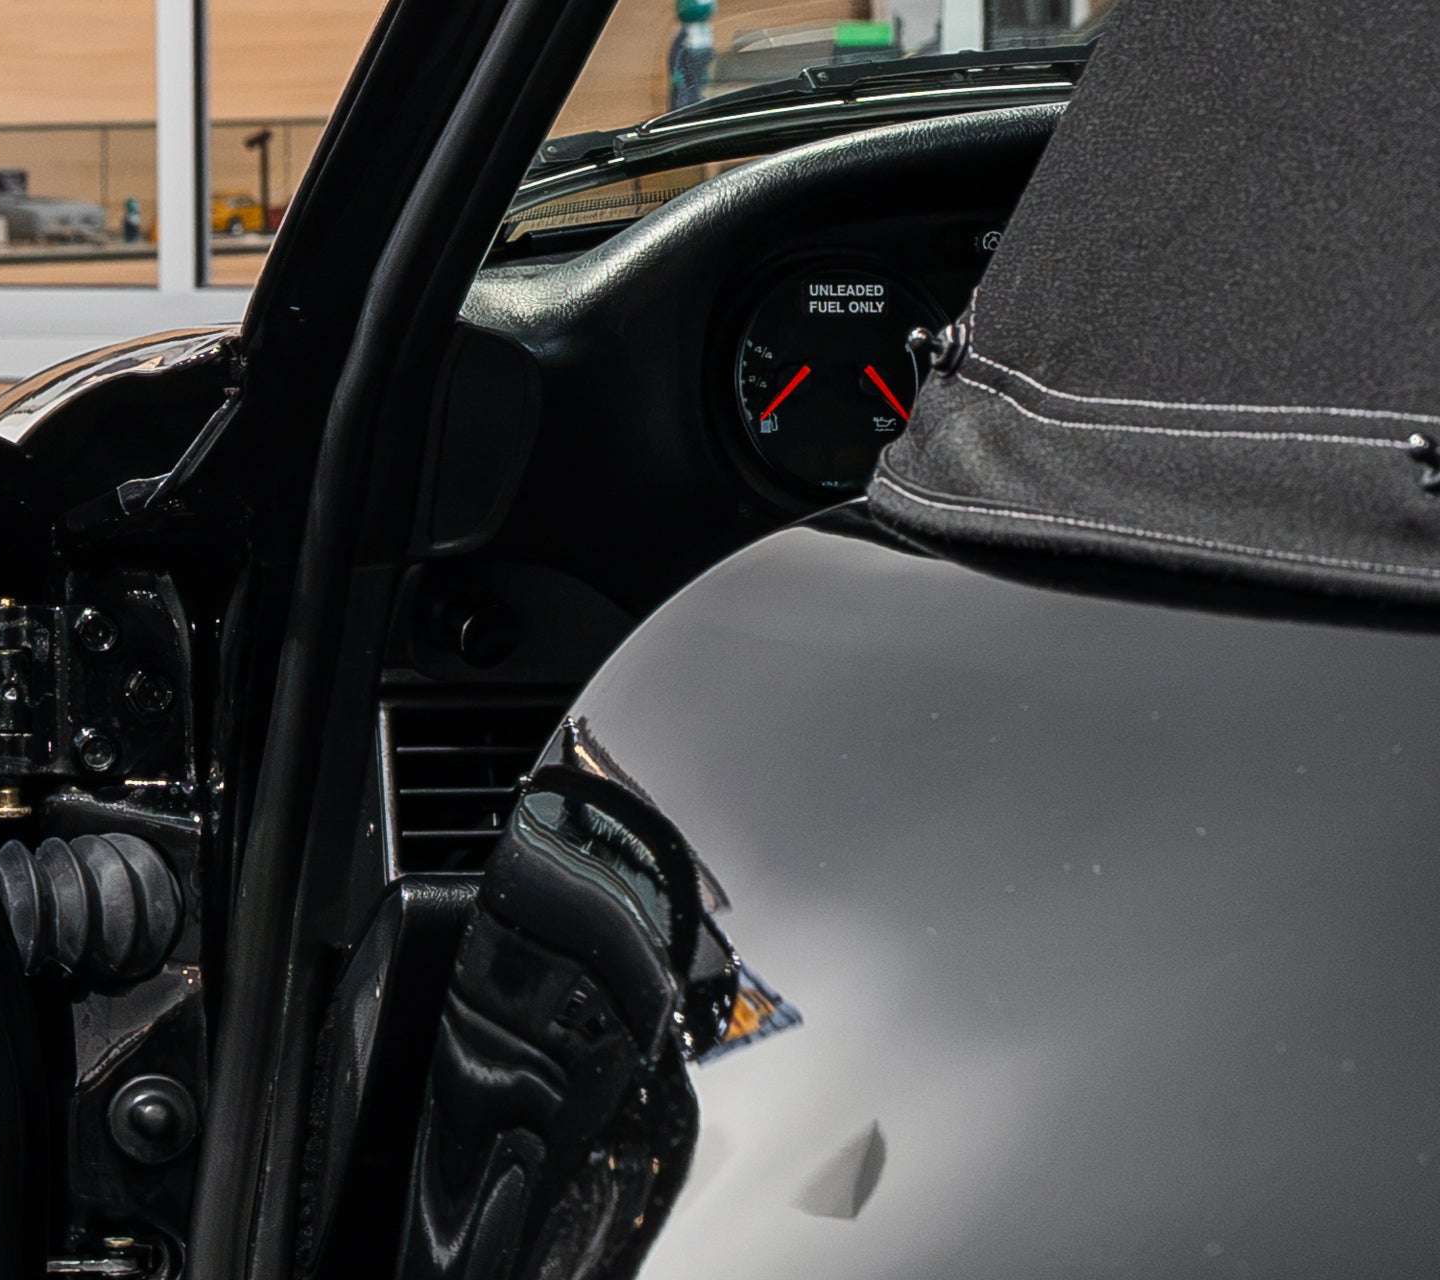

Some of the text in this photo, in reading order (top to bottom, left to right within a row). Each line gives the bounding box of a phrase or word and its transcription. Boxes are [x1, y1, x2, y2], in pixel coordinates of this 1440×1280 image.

[808, 284, 885, 297] UNLEADED
[808, 301, 885, 314] FUEL ONLY
